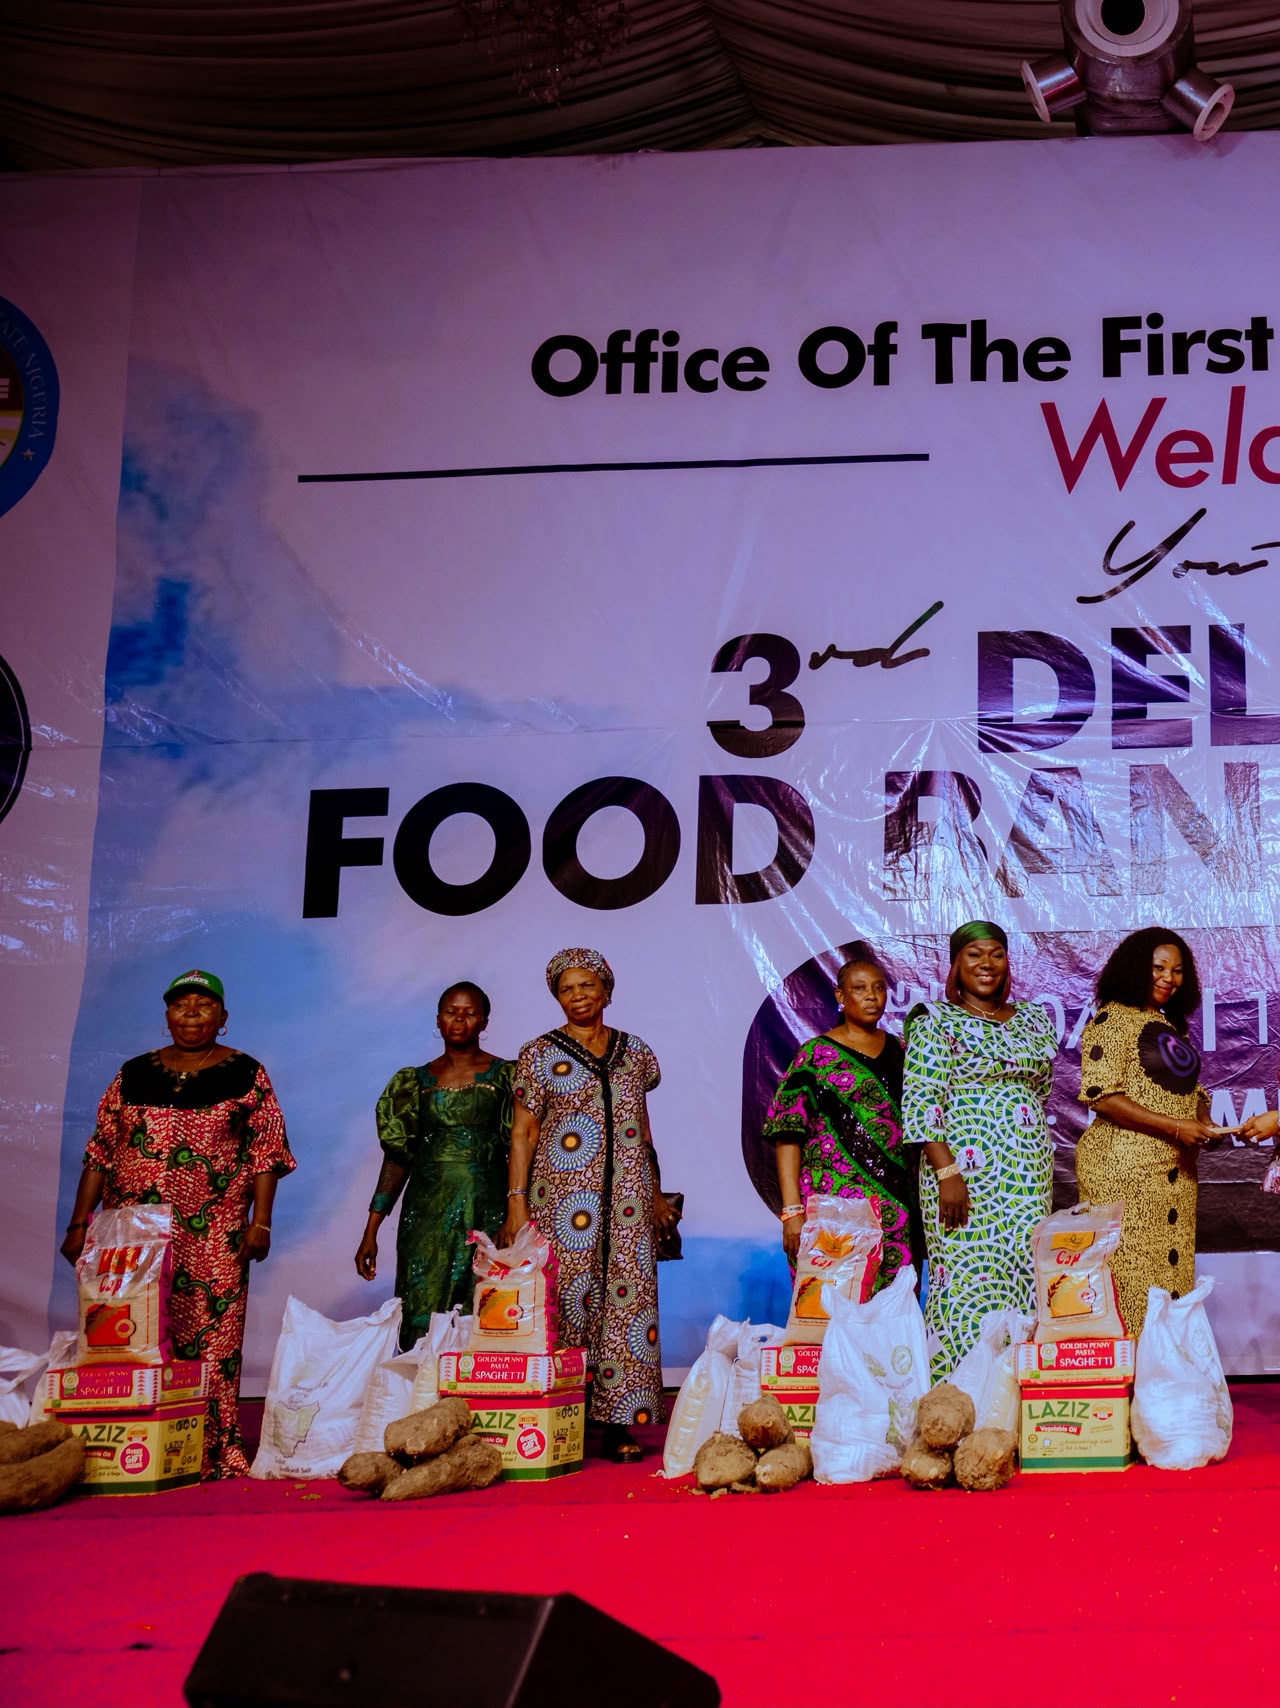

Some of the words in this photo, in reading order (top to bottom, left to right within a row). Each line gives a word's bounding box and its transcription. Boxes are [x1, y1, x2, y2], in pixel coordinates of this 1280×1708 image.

[531, 329, 770, 397] Office
[799, 321, 897, 388] Of
[922, 319, 1071, 384] The
[1101, 312, 1273, 377] First
[23, 351, 49, 441] NIGERIA
[303, 776, 815, 918] FOOD
[1055, 1250, 1080, 1266] Cap
[1060, 1342, 1088, 1350] GOLDEN
[1089, 1341, 1111, 1349] PENNY
[1060, 1356, 1113, 1367] SPAGHETTI
[475, 1371, 525, 1380] SPAGHETTI
[80, 1386, 131, 1396] SPAGHETTI
[1028, 1401, 1091, 1420] LAZIZ
[470, 1411, 516, 1430] AZIZ
[1040, 1425, 1068, 1433] Vegetable
[1068, 1425, 1078, 1433] Oil
[79, 1425, 127, 1443] AZIZ
